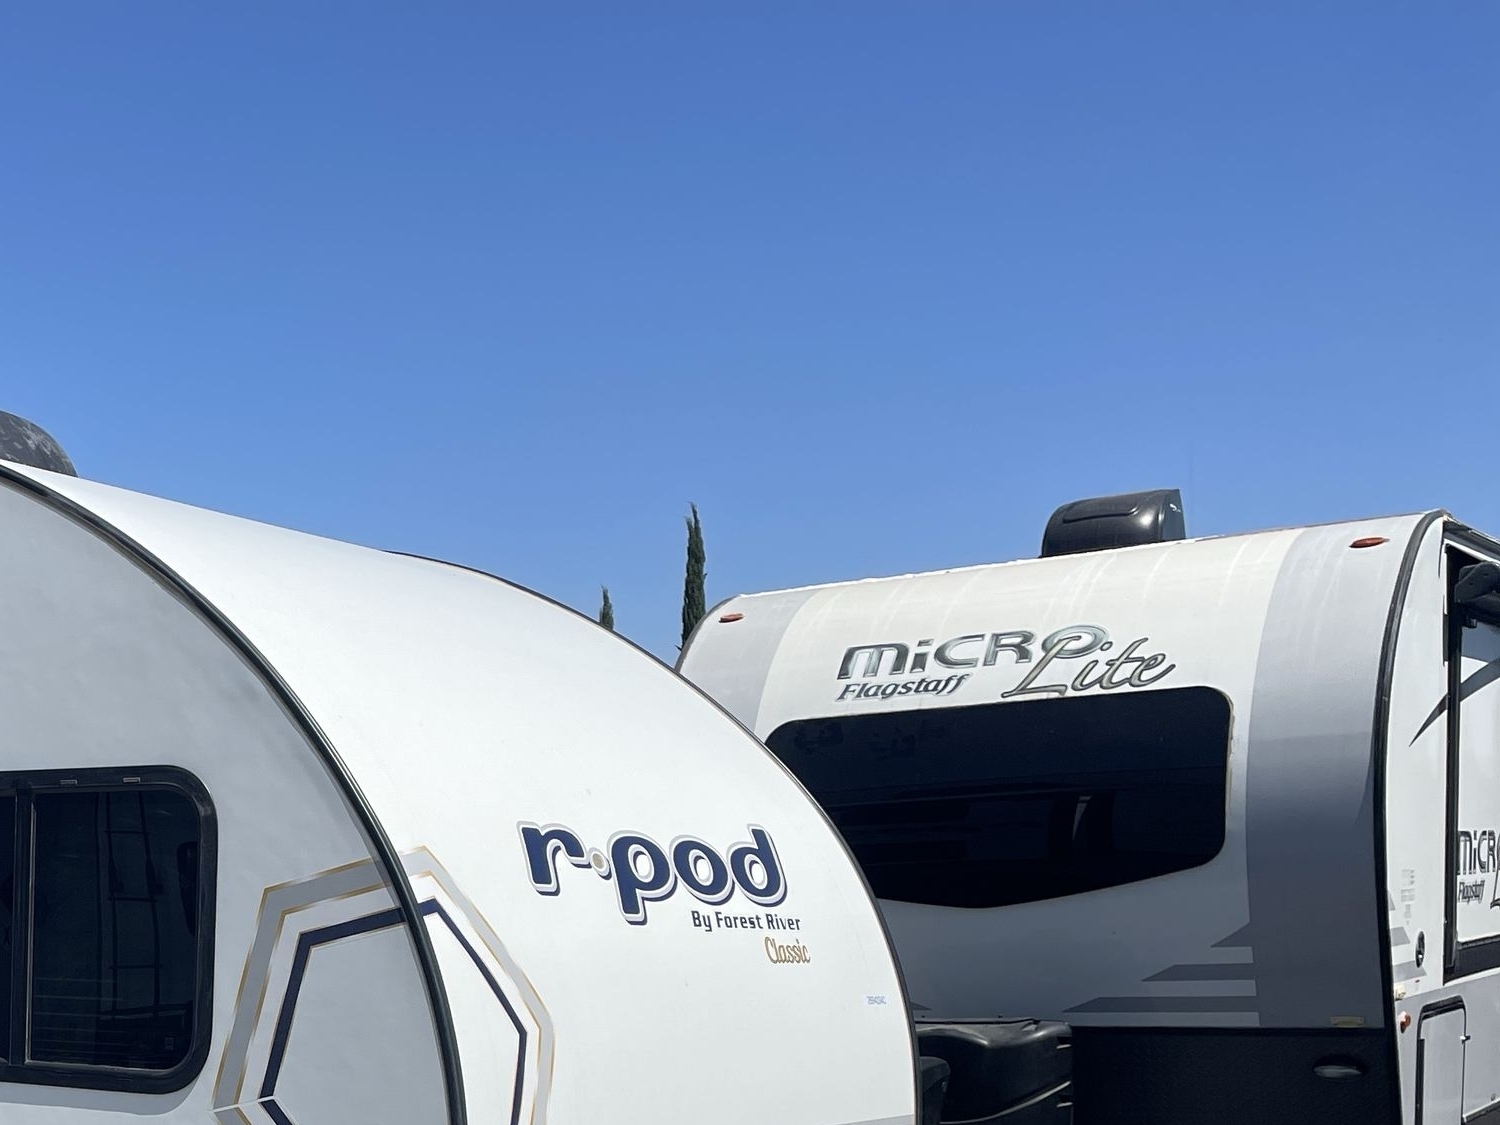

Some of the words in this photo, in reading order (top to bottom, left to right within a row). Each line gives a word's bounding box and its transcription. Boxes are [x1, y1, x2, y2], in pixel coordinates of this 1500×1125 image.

[1000, 635, 1176, 698] Lite
[835, 673, 970, 702] Flagstaff
[691, 910, 712, 932] By
[716, 911, 763, 929] Forest
[767, 913, 801, 931] River
[764, 936, 811, 964] Classic
